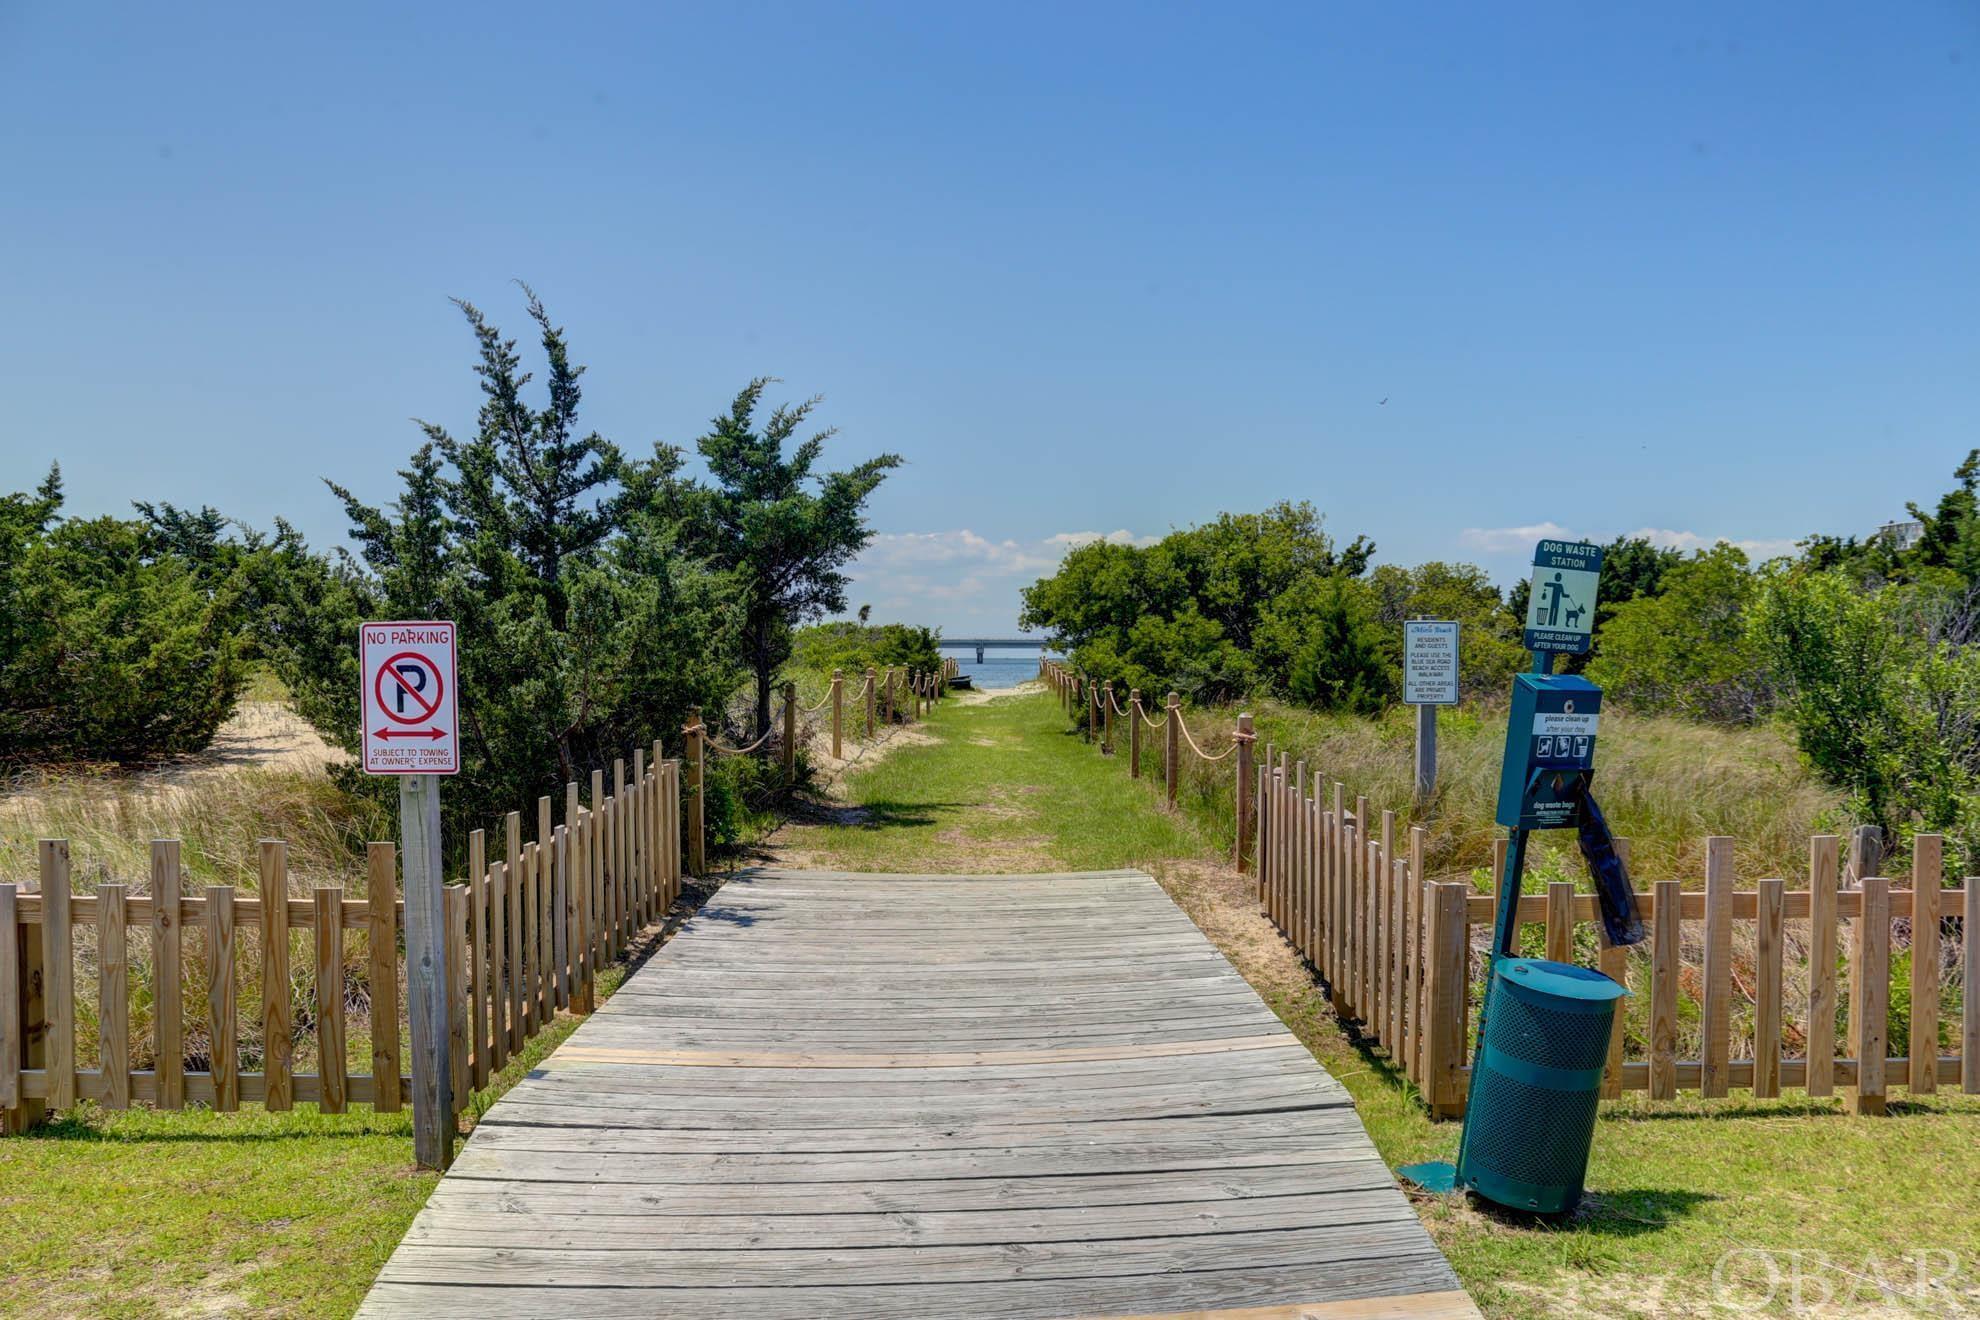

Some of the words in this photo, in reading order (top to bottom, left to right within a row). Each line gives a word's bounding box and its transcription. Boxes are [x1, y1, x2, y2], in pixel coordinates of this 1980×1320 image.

[1543, 542, 1562, 553] DOG
[1565, 544, 1597, 557] WASTE
[1551, 556, 1586, 568] STATION
[367, 632, 386, 645] NO
[391, 631, 449, 645] PARKING
[1534, 632, 1554, 640] PLEASE
[1555, 633, 1573, 642] CLEAN
[1533, 642, 1552, 650] AFTER
[396, 665, 426, 713] P
[1545, 715, 1564, 723] please
[373, 748, 404, 757] SUBJECT
[408, 748, 416, 757] TO
[420, 748, 449, 757] TOWING
[370, 758, 378, 766] AT
[418, 757, 452, 766] EXPENSE
[1533, 801, 1544, 810] dog
[1562, 801, 1575, 809] bags
